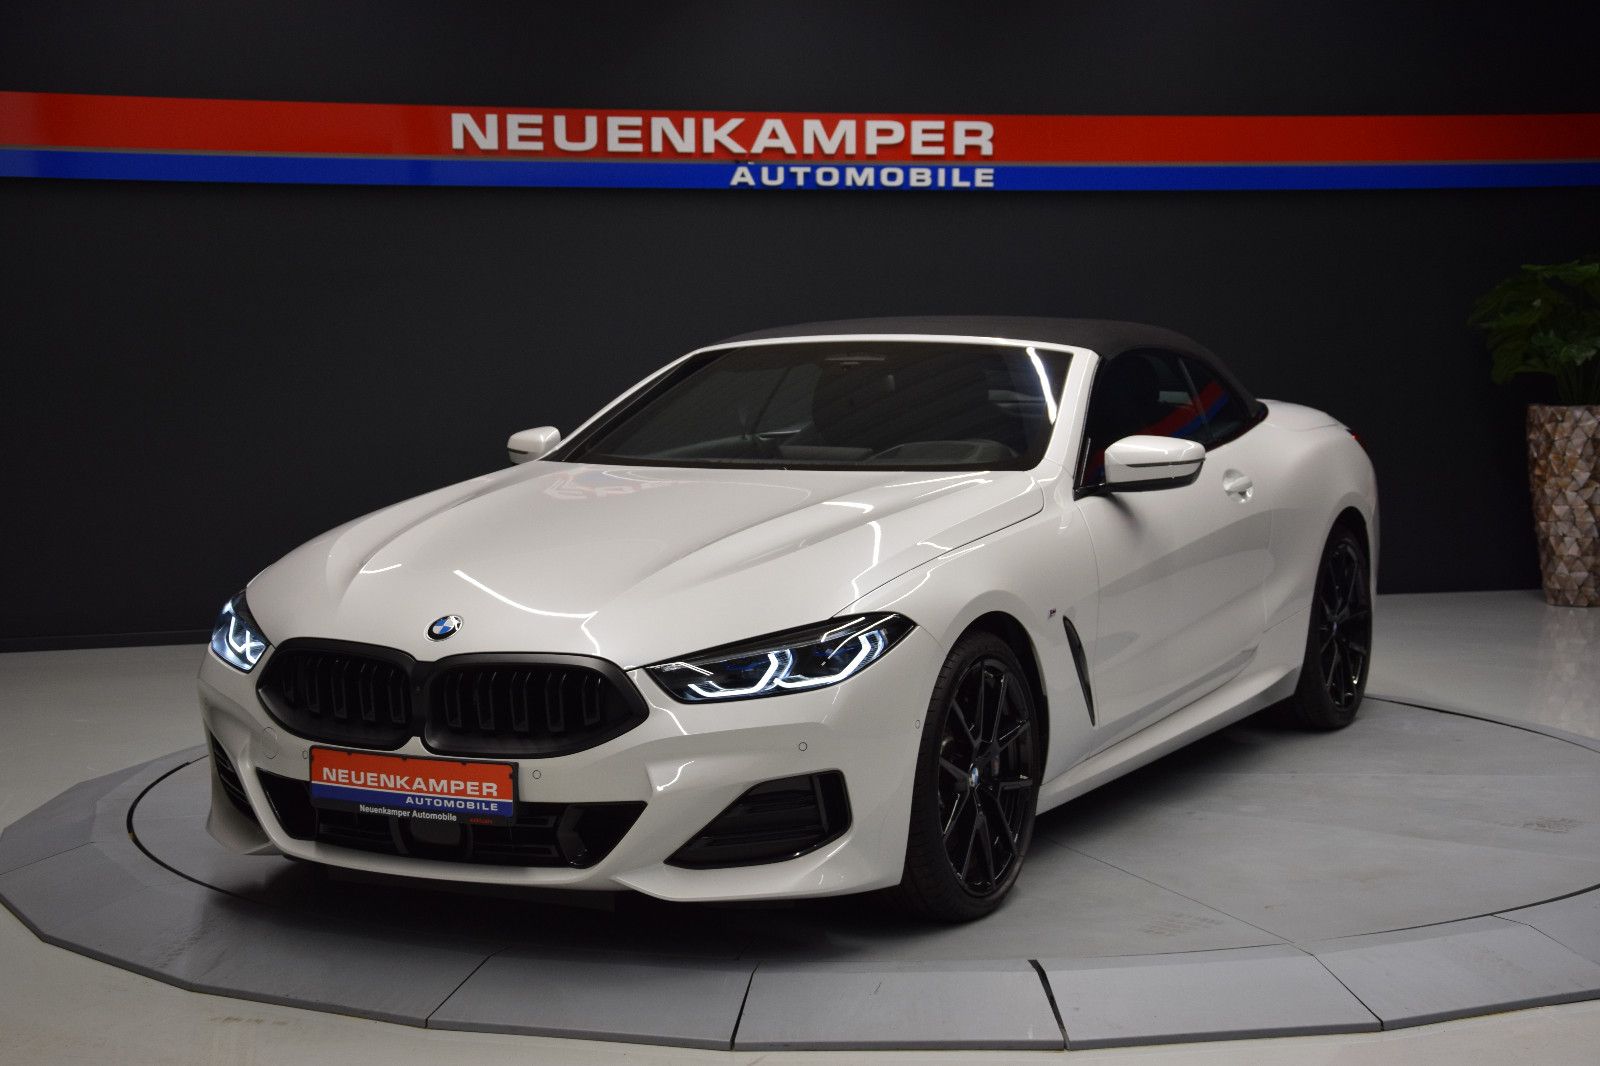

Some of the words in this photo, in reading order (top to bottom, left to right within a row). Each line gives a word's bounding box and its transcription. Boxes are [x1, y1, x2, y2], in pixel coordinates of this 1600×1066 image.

[450, 113, 995, 156] NEUENKAMPER
[730, 165, 995, 188] AUTOMOBILE
[322, 767, 498, 797] NEUENKAMPER
[359, 804, 411, 818] Neuenkamper
[412, 810, 457, 822] Automobile
[405, 796, 498, 811] AUTOMOBILE
